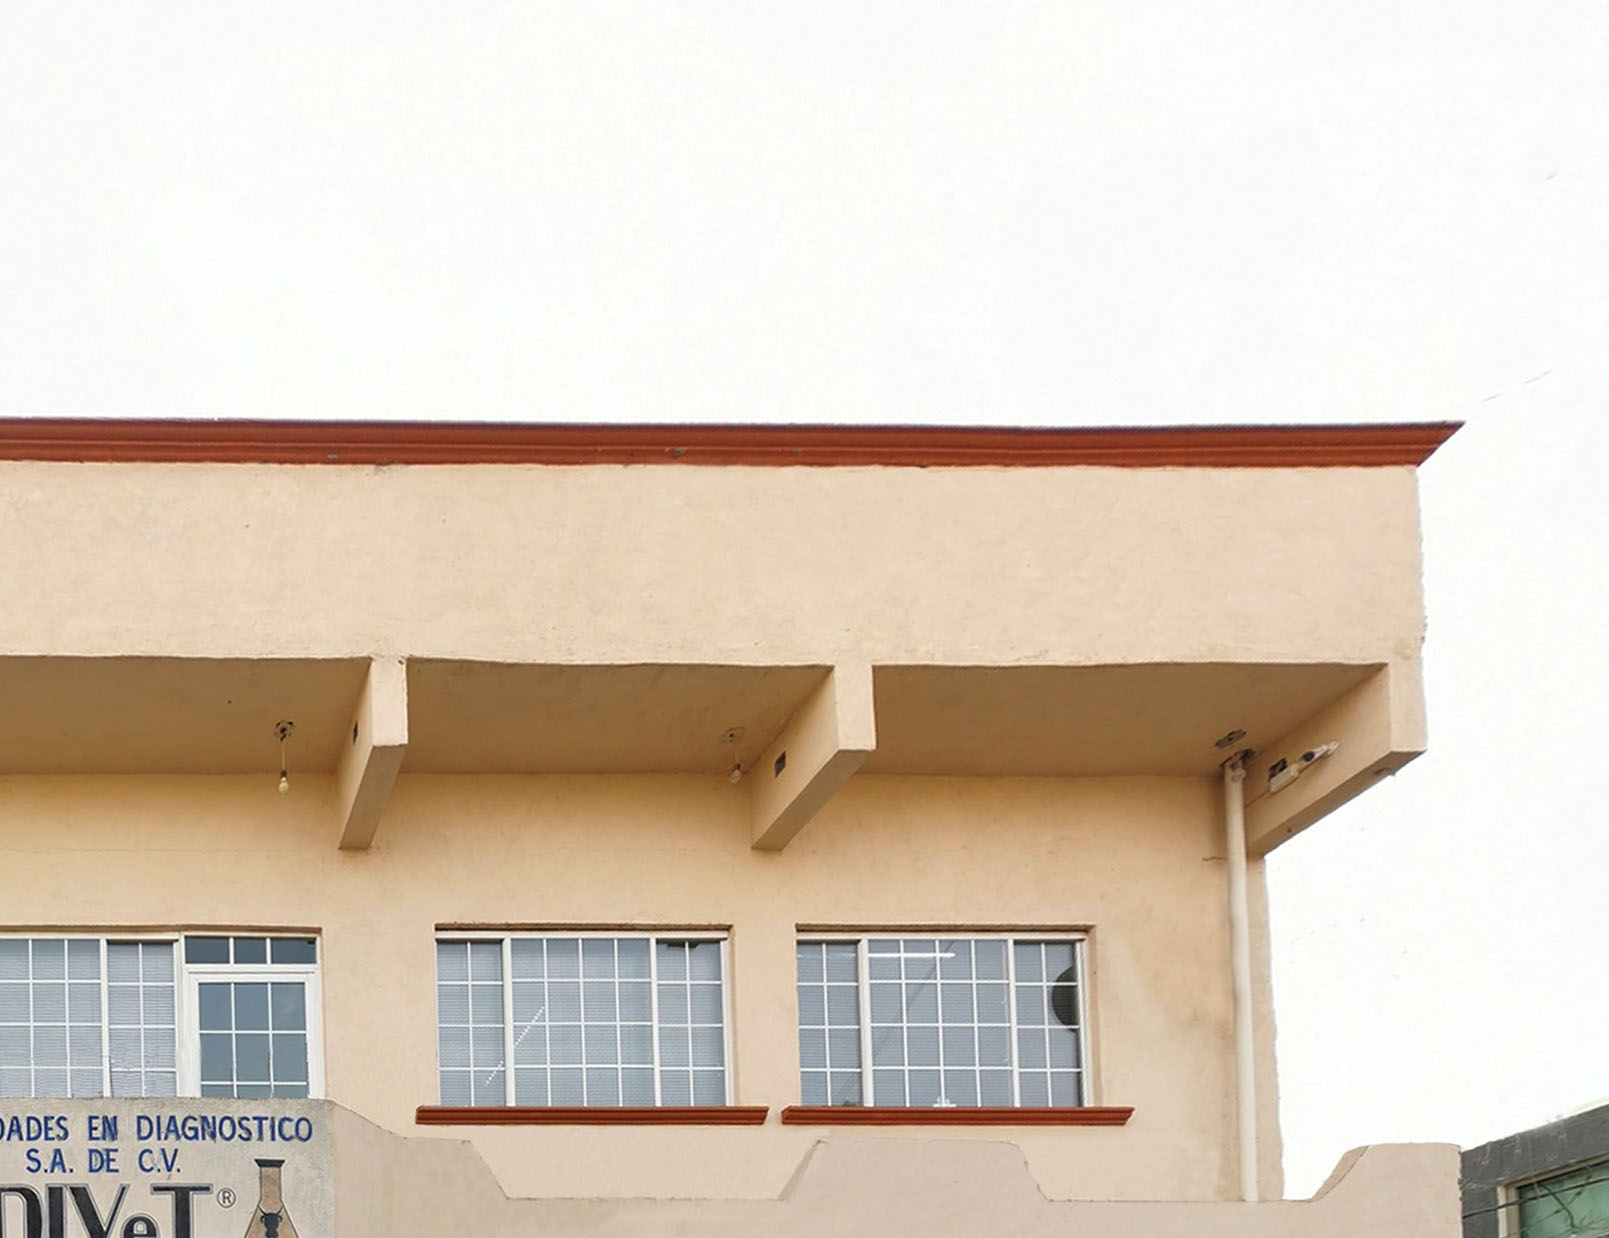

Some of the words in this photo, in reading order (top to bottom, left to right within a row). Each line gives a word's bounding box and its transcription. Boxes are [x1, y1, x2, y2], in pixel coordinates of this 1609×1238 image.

[88, 1115, 119, 1142] EN
[136, 1115, 313, 1143] DIAGNOSTICO
[25, 1148, 75, 1174] S.A.
[88, 1148, 119, 1173] DE
[138, 1148, 182, 1173] C.V.
